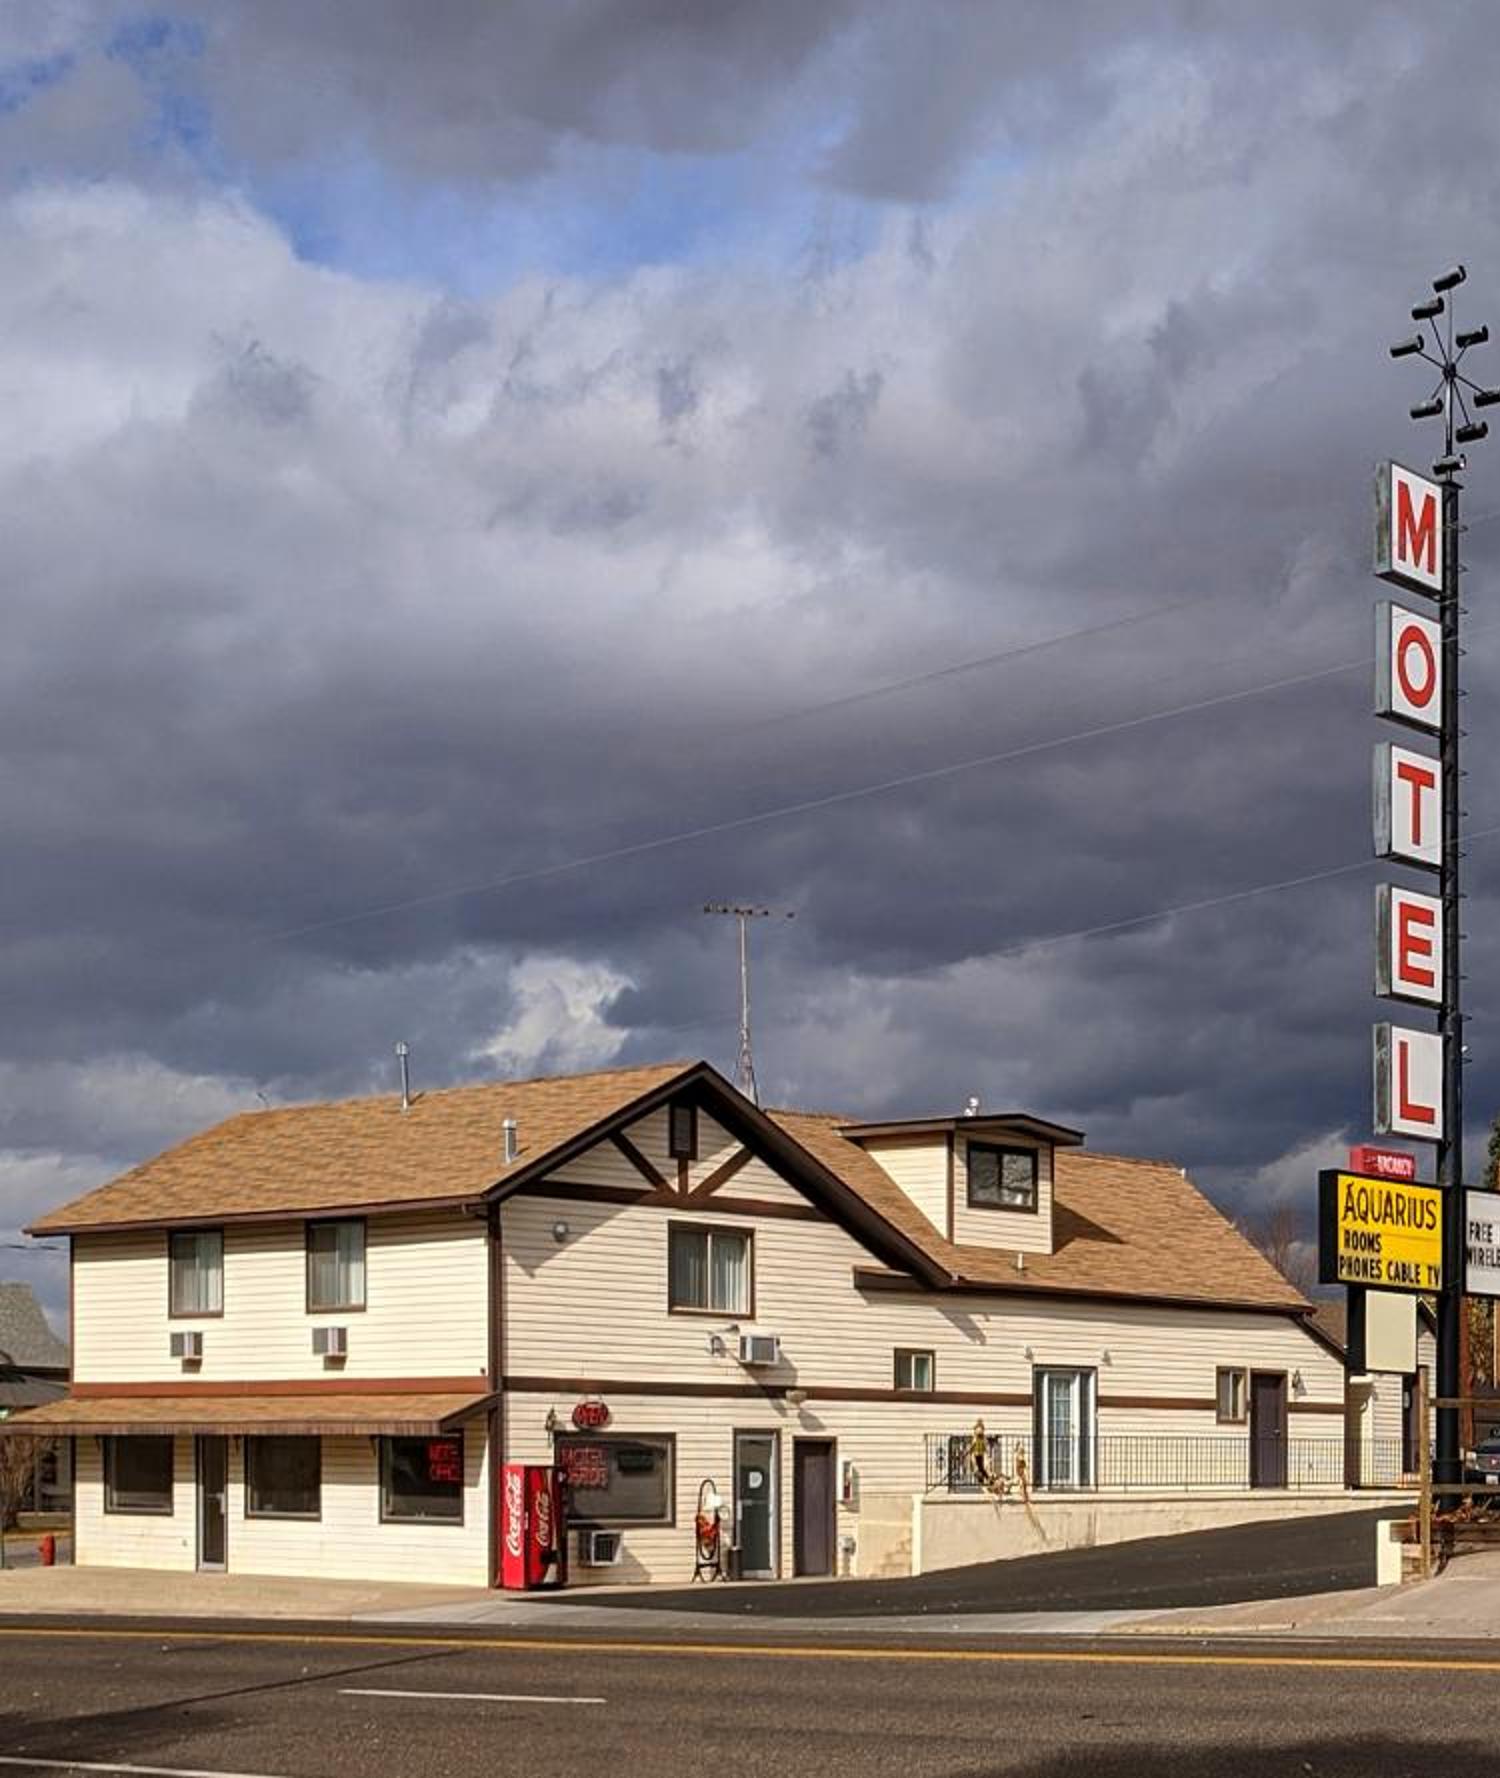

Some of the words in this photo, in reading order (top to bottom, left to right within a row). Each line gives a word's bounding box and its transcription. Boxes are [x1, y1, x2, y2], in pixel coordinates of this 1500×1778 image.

[1397, 479, 1437, 1125] MOTEL
[1342, 1182, 1437, 1230] AQUARIUS
[1344, 1230, 1382, 1253] ROOMS
[1469, 1221, 1493, 1244] FREE
[1339, 1255, 1383, 1280] PHONES
[1387, 1261, 1421, 1284] CABLE
[1427, 1265, 1440, 1287] TV
